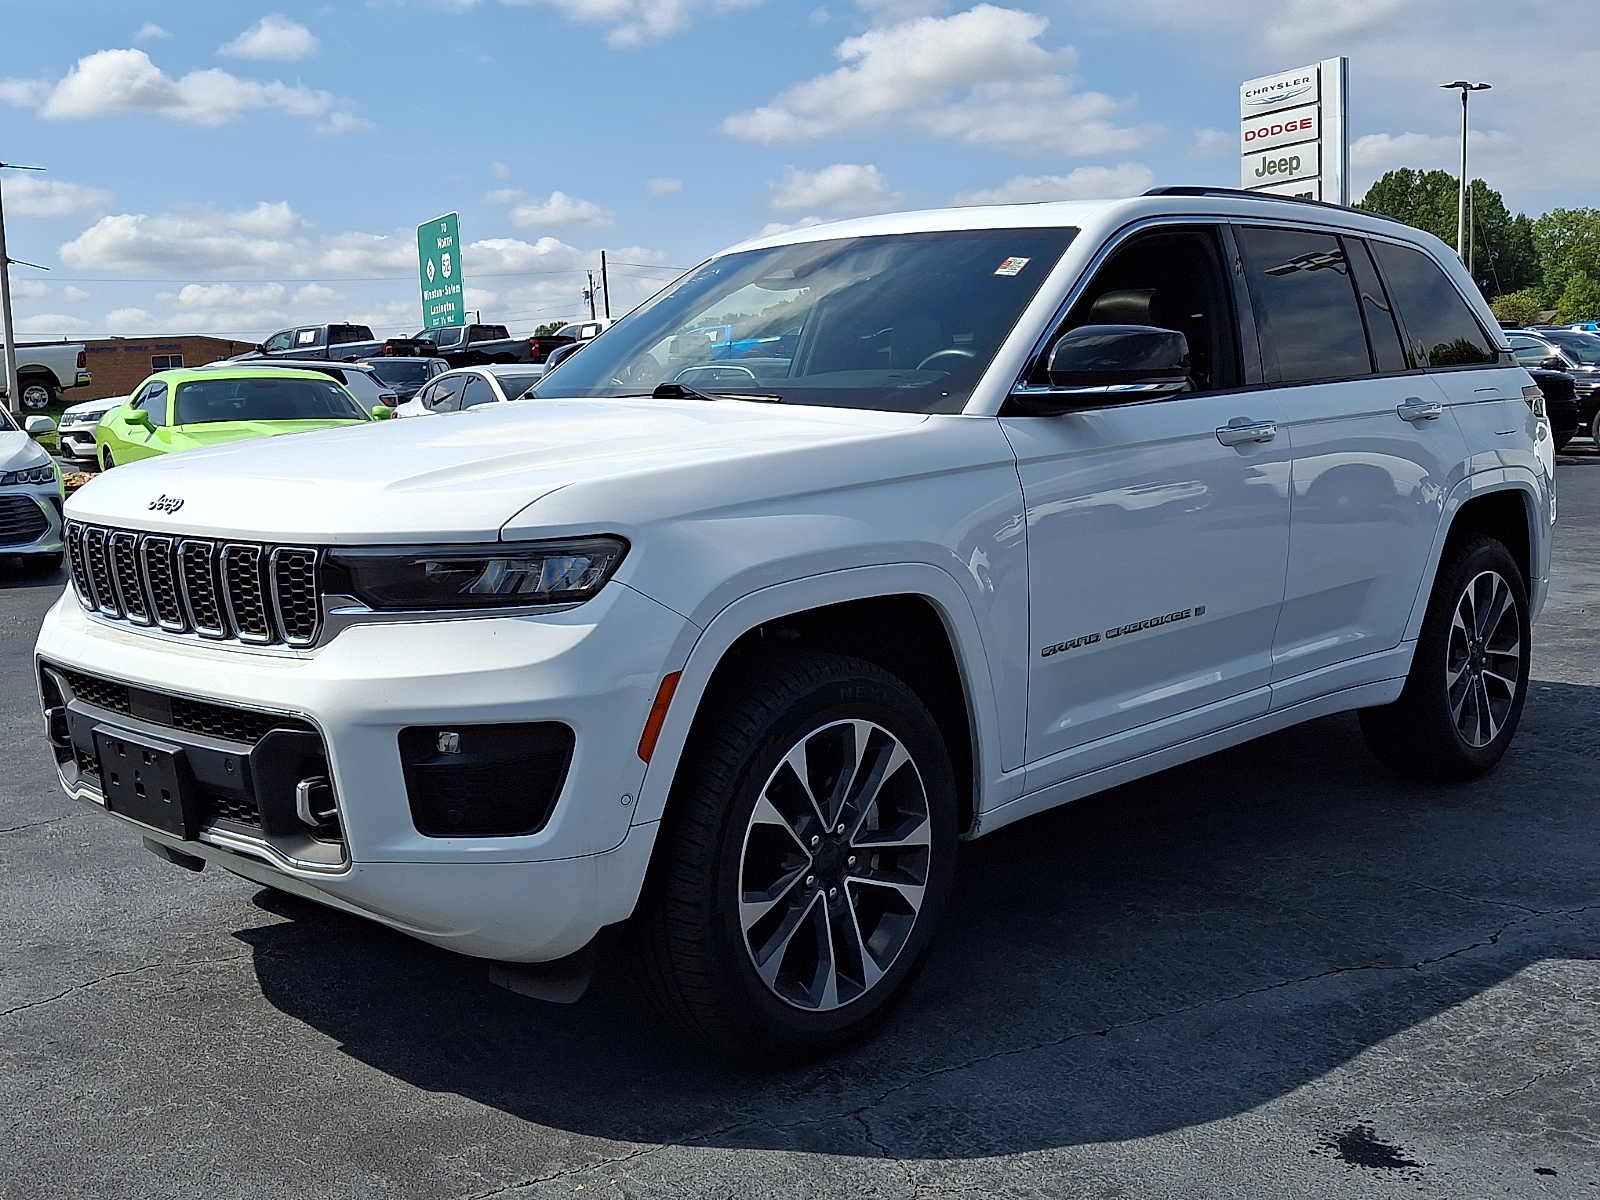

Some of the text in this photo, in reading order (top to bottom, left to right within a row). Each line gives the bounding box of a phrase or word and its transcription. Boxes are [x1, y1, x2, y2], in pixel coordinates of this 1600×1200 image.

[1245, 77, 1310, 98] CHRYSLER
[1244, 117, 1313, 142] DODGE
[1254, 155, 1301, 178] Jeep
[436, 236, 453, 250] NORTH
[442, 258, 450, 273] 52
[423, 284, 461, 301] Winston-Salem
[430, 301, 456, 316] Lexington
[147, 494, 185, 515] Jeep
[1041, 608, 1191, 658] GRAND CHEROKEE
